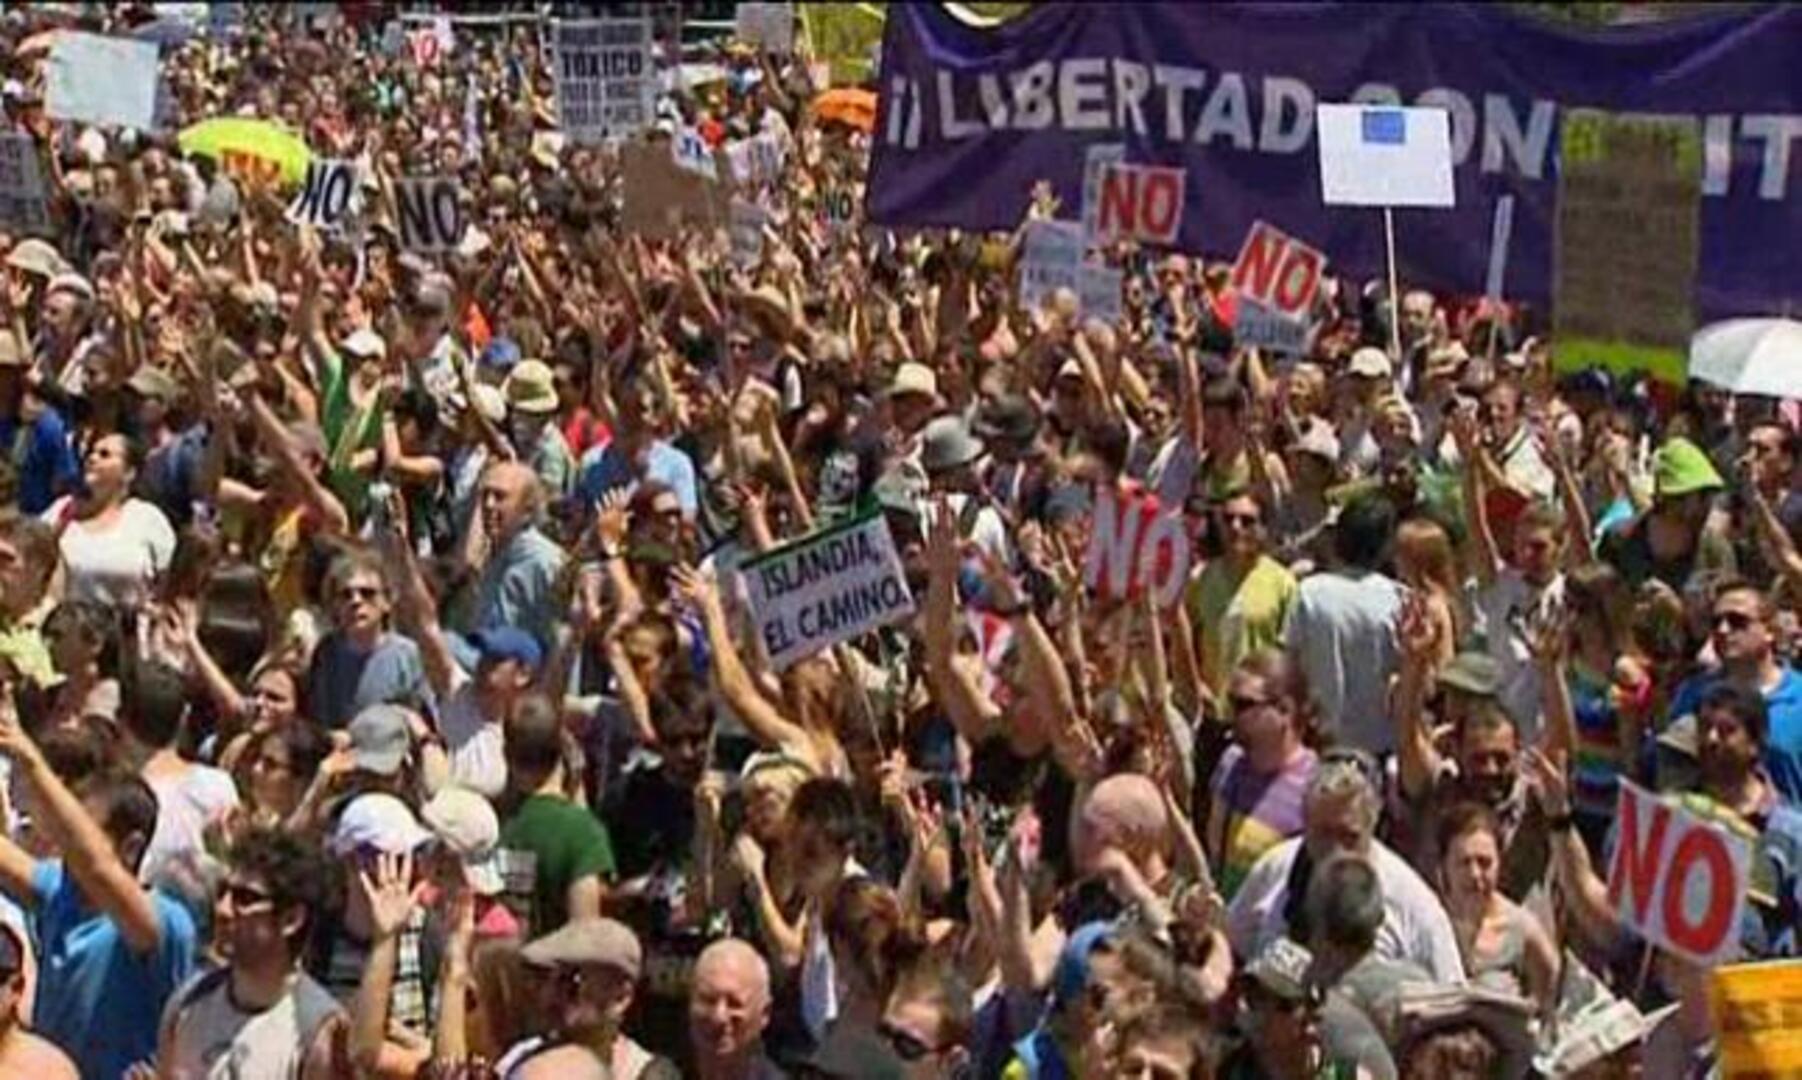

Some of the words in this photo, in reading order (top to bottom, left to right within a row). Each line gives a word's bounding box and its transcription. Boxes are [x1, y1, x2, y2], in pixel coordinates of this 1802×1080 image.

[297, 163, 350, 224] NO
[395, 181, 459, 246] NO
[1098, 169, 1179, 236] NO
[1233, 230, 1319, 313] NO
[760, 532, 879, 600] ISLANDIA,
[1083, 485, 1190, 609] NO
[764, 617, 795, 656] EL
[1608, 783, 1737, 955] NO
